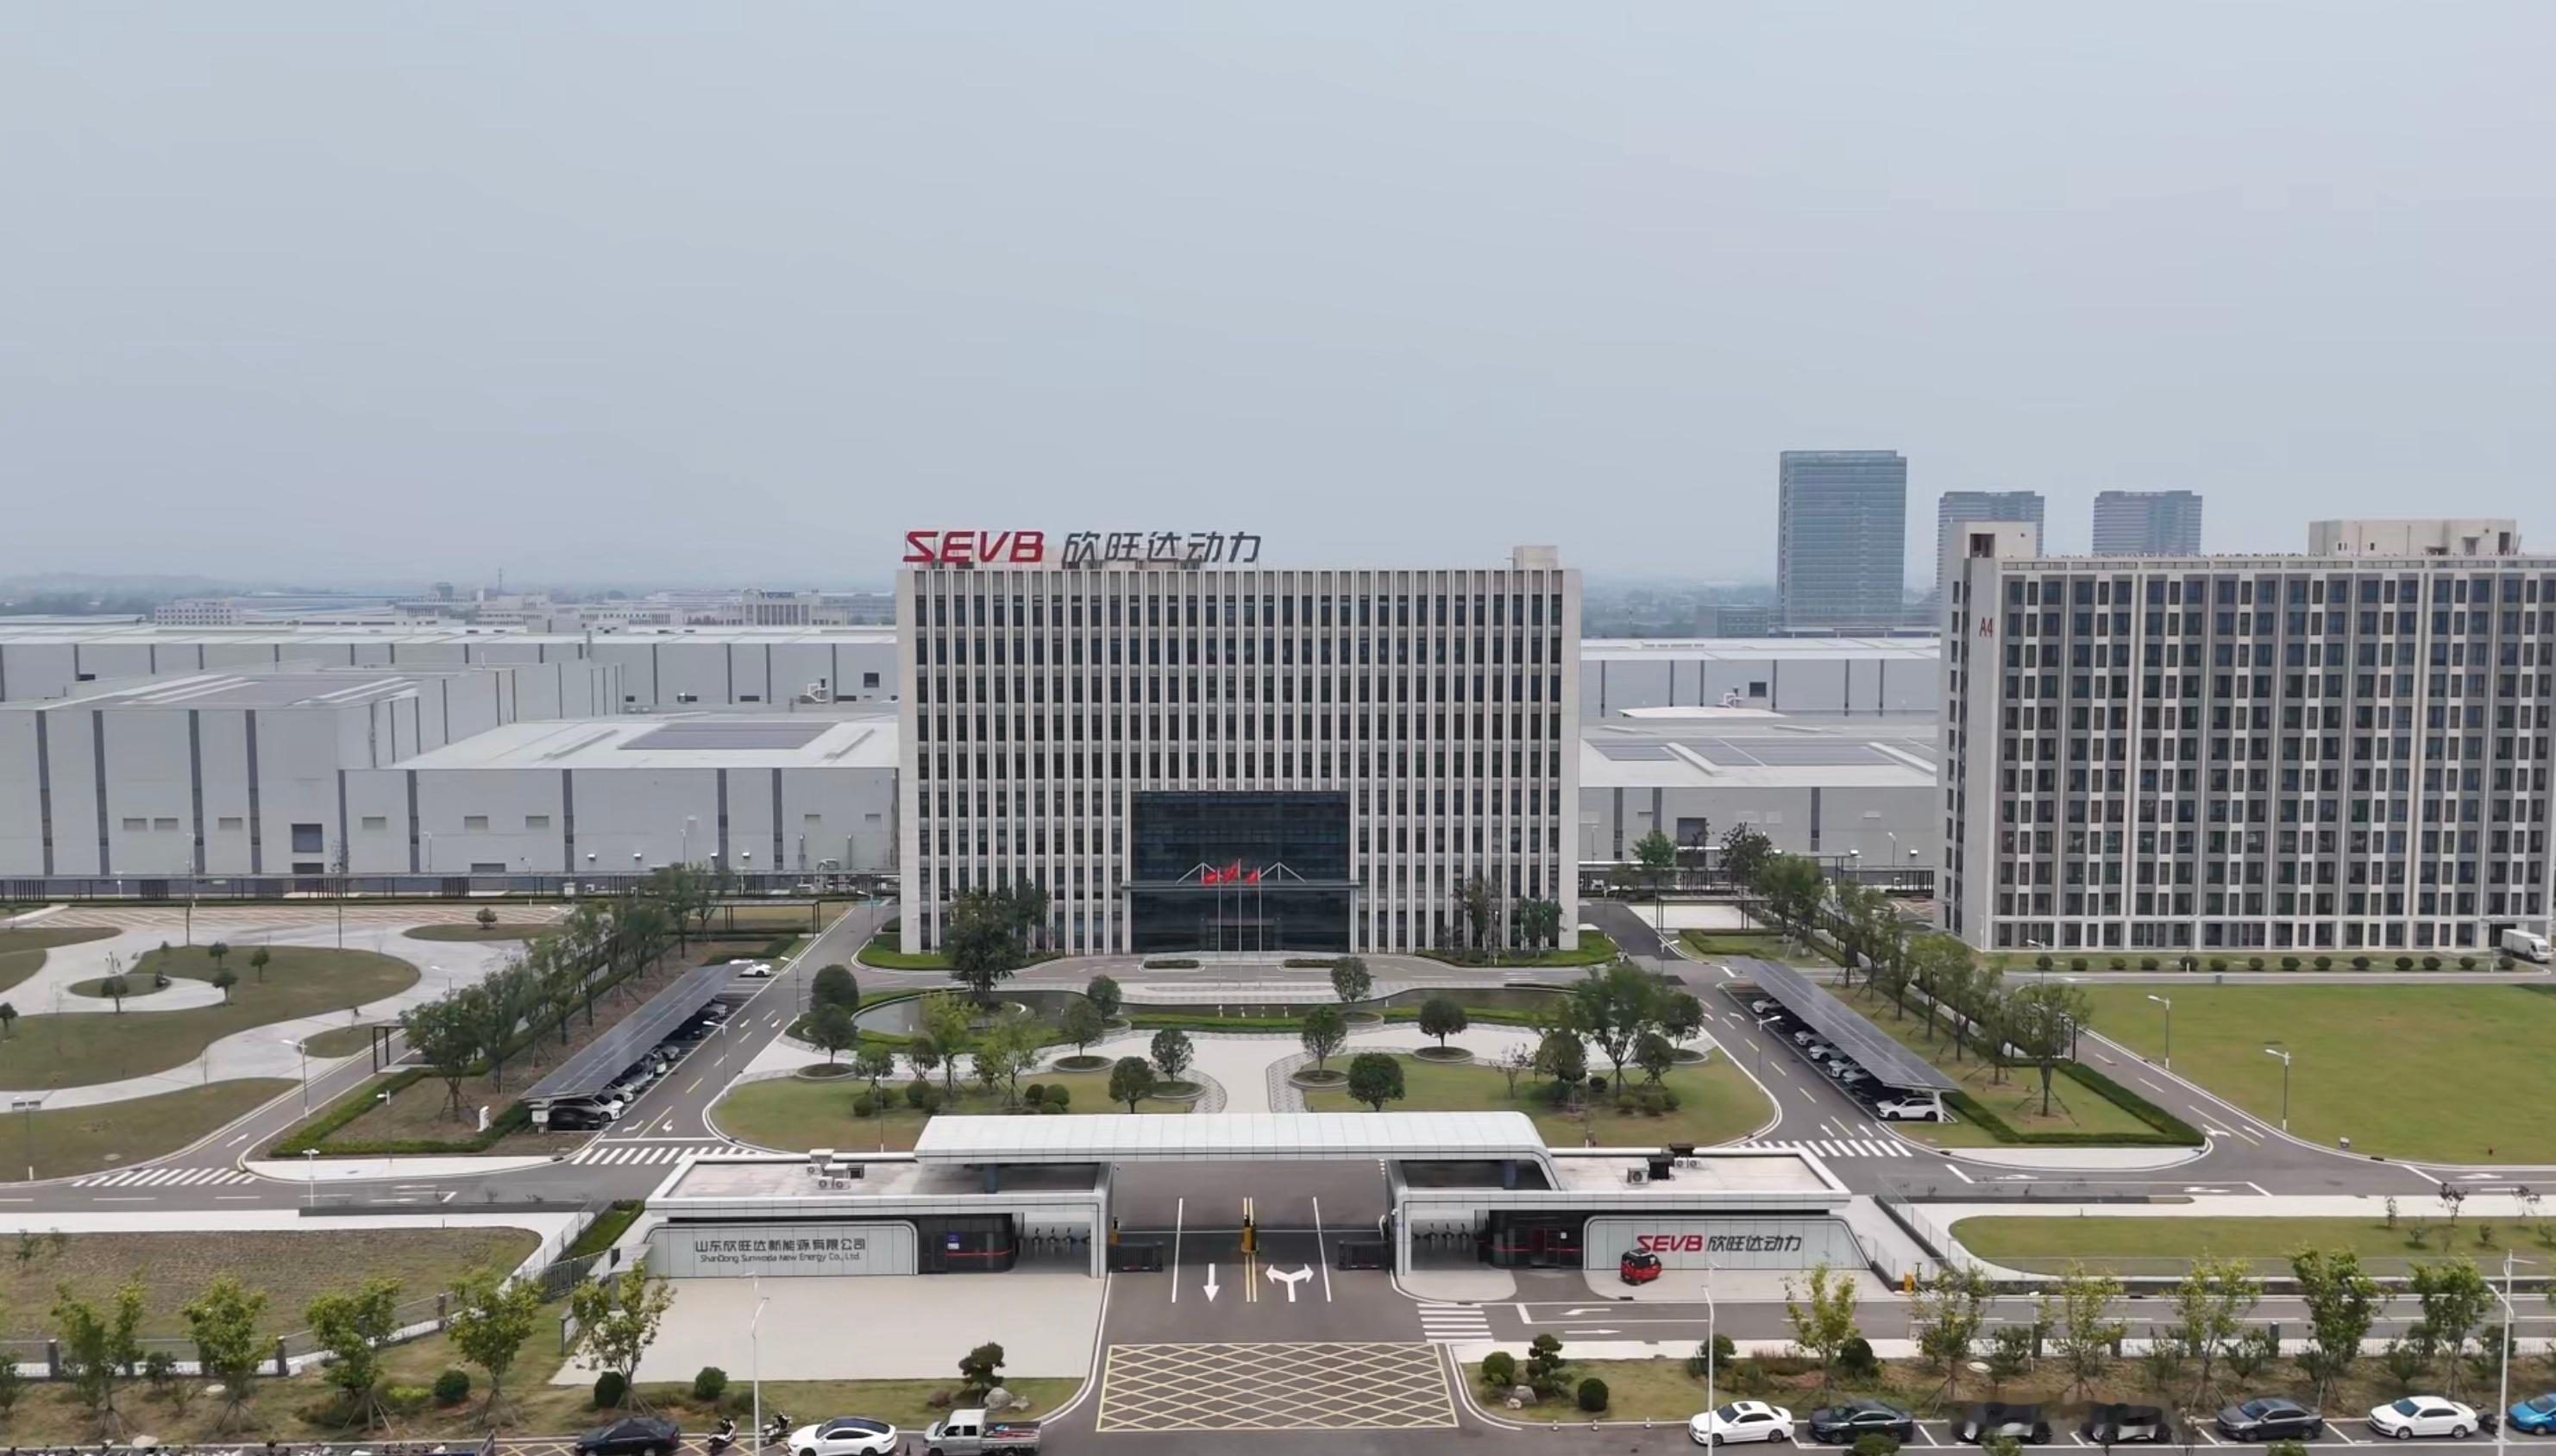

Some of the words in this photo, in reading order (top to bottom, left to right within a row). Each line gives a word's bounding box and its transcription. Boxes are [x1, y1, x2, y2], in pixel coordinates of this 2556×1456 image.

[902, 530, 1044, 562] SEVB
[1062, 531, 1261, 565] 欣旺达动力
[1979, 617, 1994, 638] A4
[695, 1239, 865, 1253] 山东欣旺达新能源有限公司
[1637, 1235, 1703, 1252] SEVB
[1707, 1235, 1802, 1252] 欣旺达动力
[799, 1253, 827, 1262] Energy
